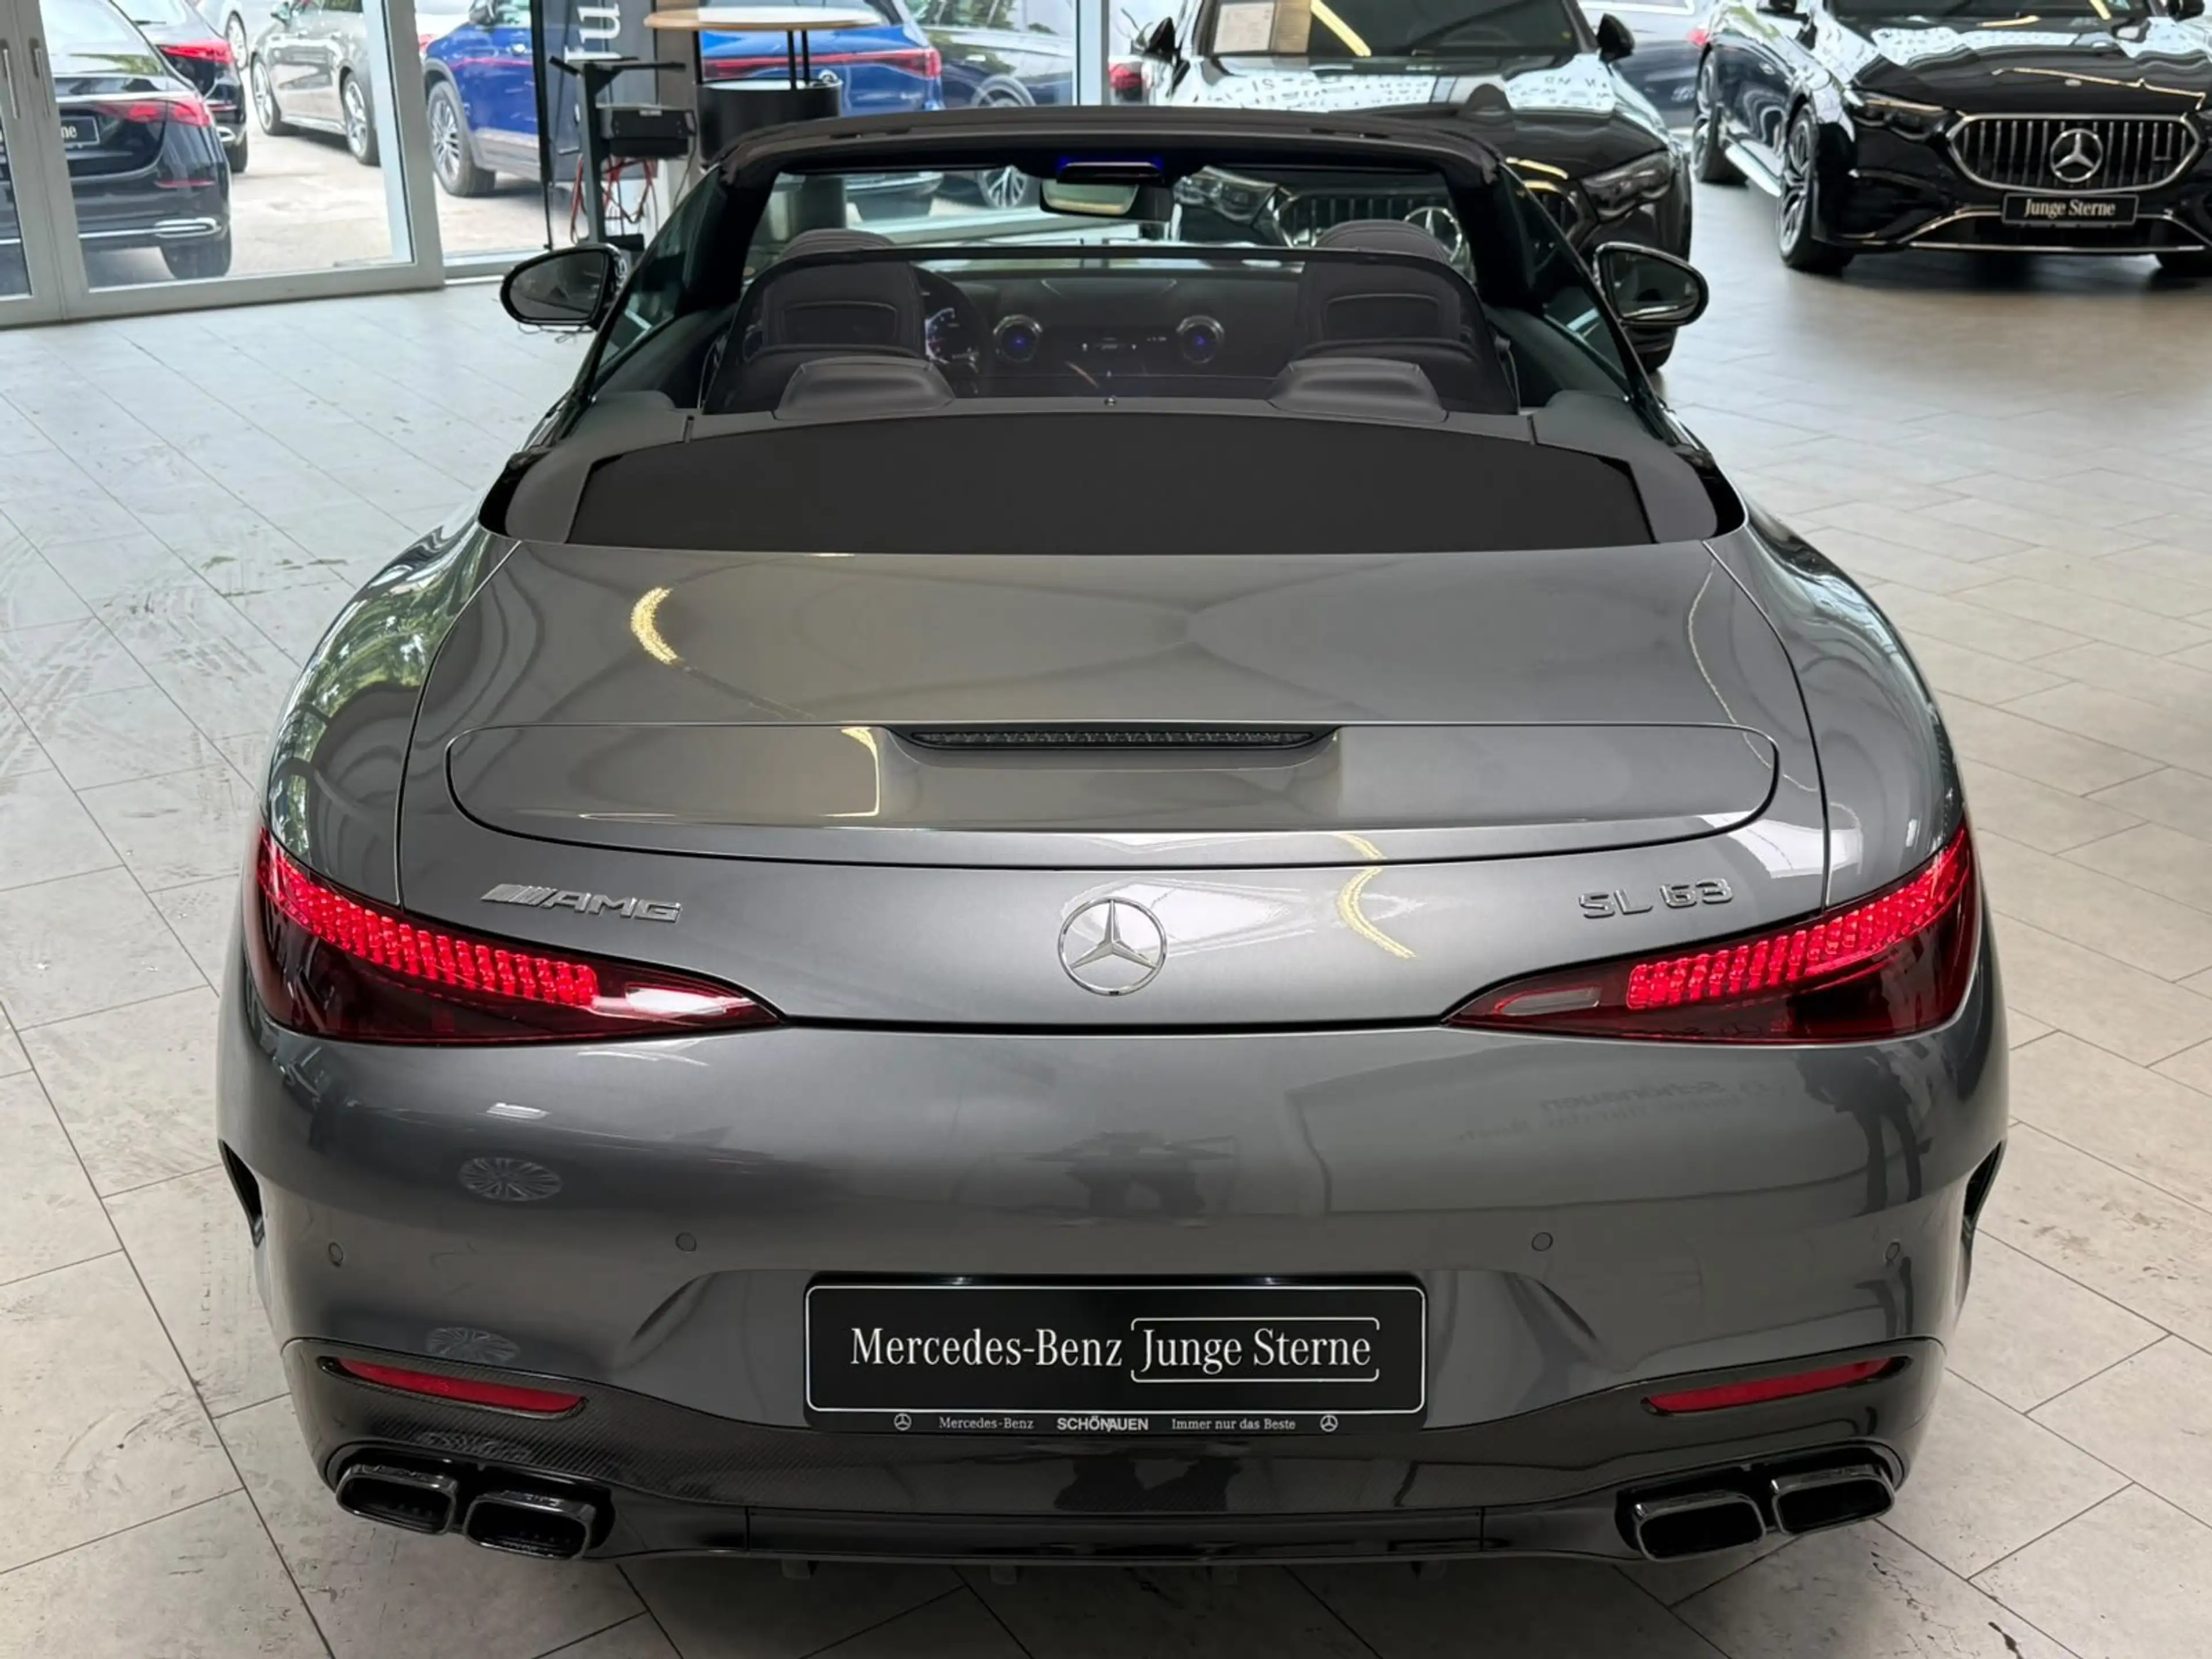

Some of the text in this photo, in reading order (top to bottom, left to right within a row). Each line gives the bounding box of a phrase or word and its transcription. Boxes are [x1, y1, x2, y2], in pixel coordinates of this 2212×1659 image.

[2024, 198, 2116, 219] Junge Sterne
[539, 889, 682, 922] AMG
[1579, 878, 1734, 919] SL 63
[850, 1327, 1371, 1375] Mercedes-Benz Junge Sterne
[938, 1415, 1296, 1433] Mercedes-Benz SCHÖNAUEN Immer nur das Beste
